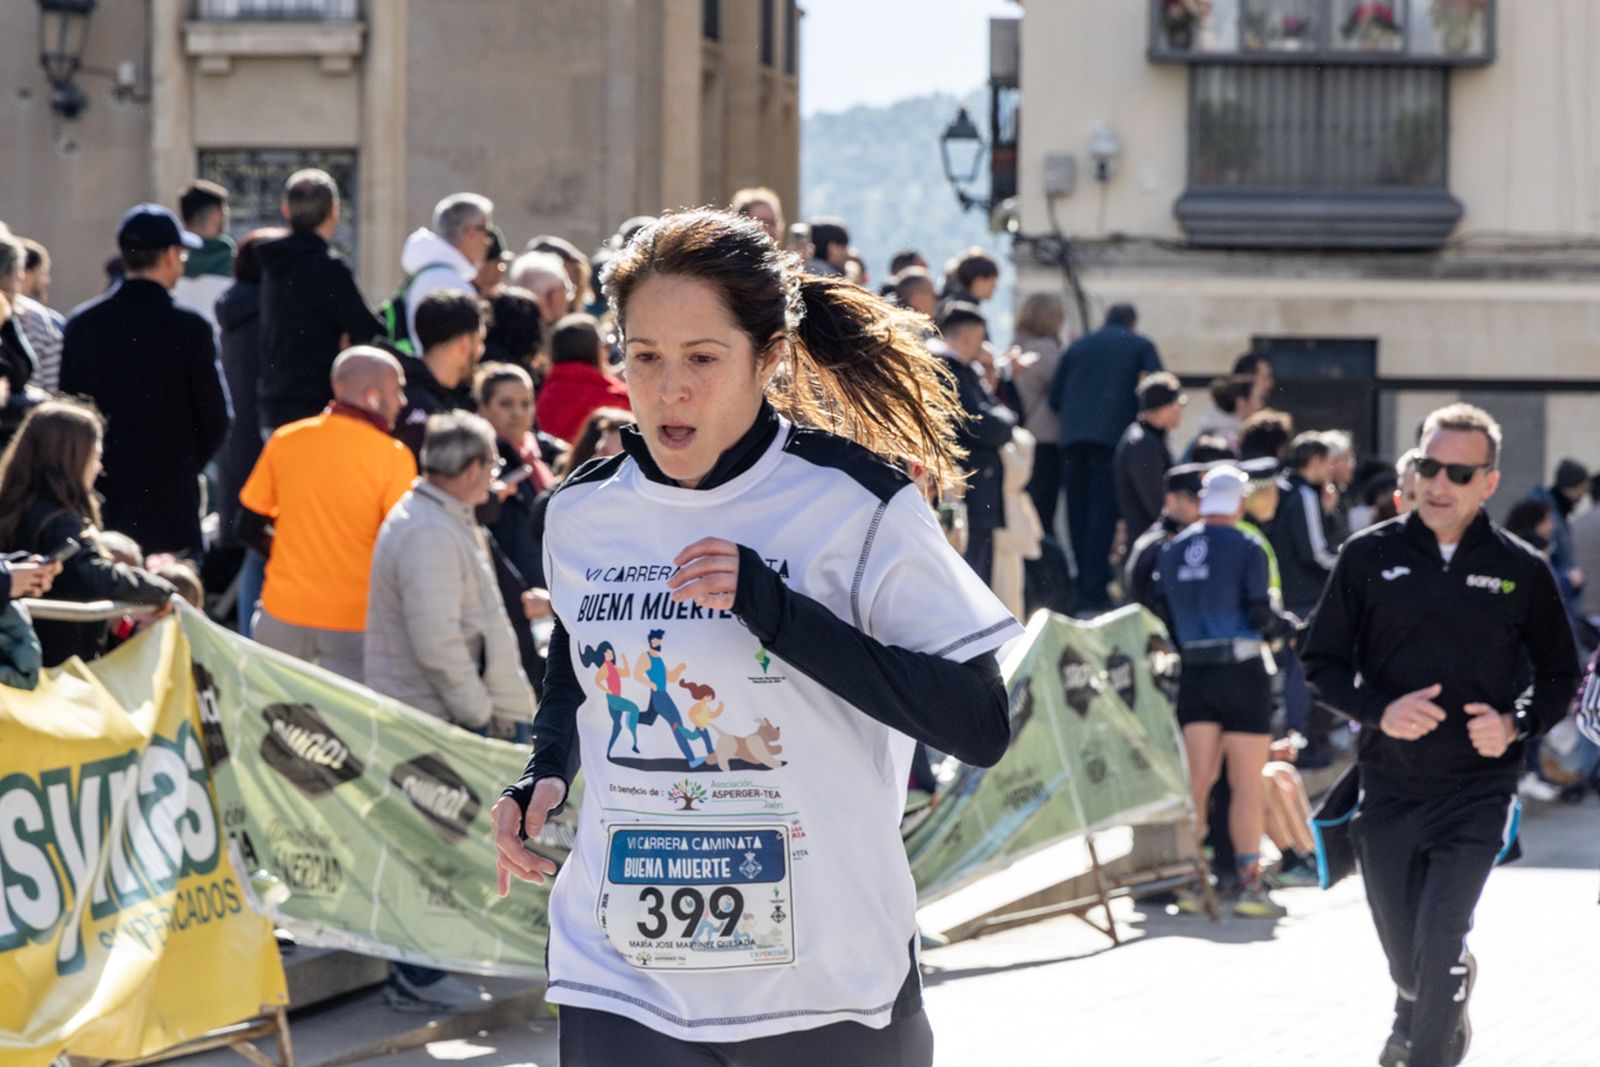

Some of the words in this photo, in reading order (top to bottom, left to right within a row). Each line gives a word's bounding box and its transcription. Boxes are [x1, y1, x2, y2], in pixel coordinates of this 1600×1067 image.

[577, 592, 634, 622] BUENA
[609, 783, 617, 792] En
[618, 785, 647, 796] beneficio
[711, 789, 781, 799] ASPERGER-TEA
[637, 836, 689, 850] CARRERA
[691, 836, 763, 850] CAMINATA
[624, 857, 664, 879] BUENA
[668, 857, 732, 880] MUERTE
[637, 886, 745, 940] 399
[655, 940, 673, 949] JOSE
[716, 938, 757, 949] QUESADA
